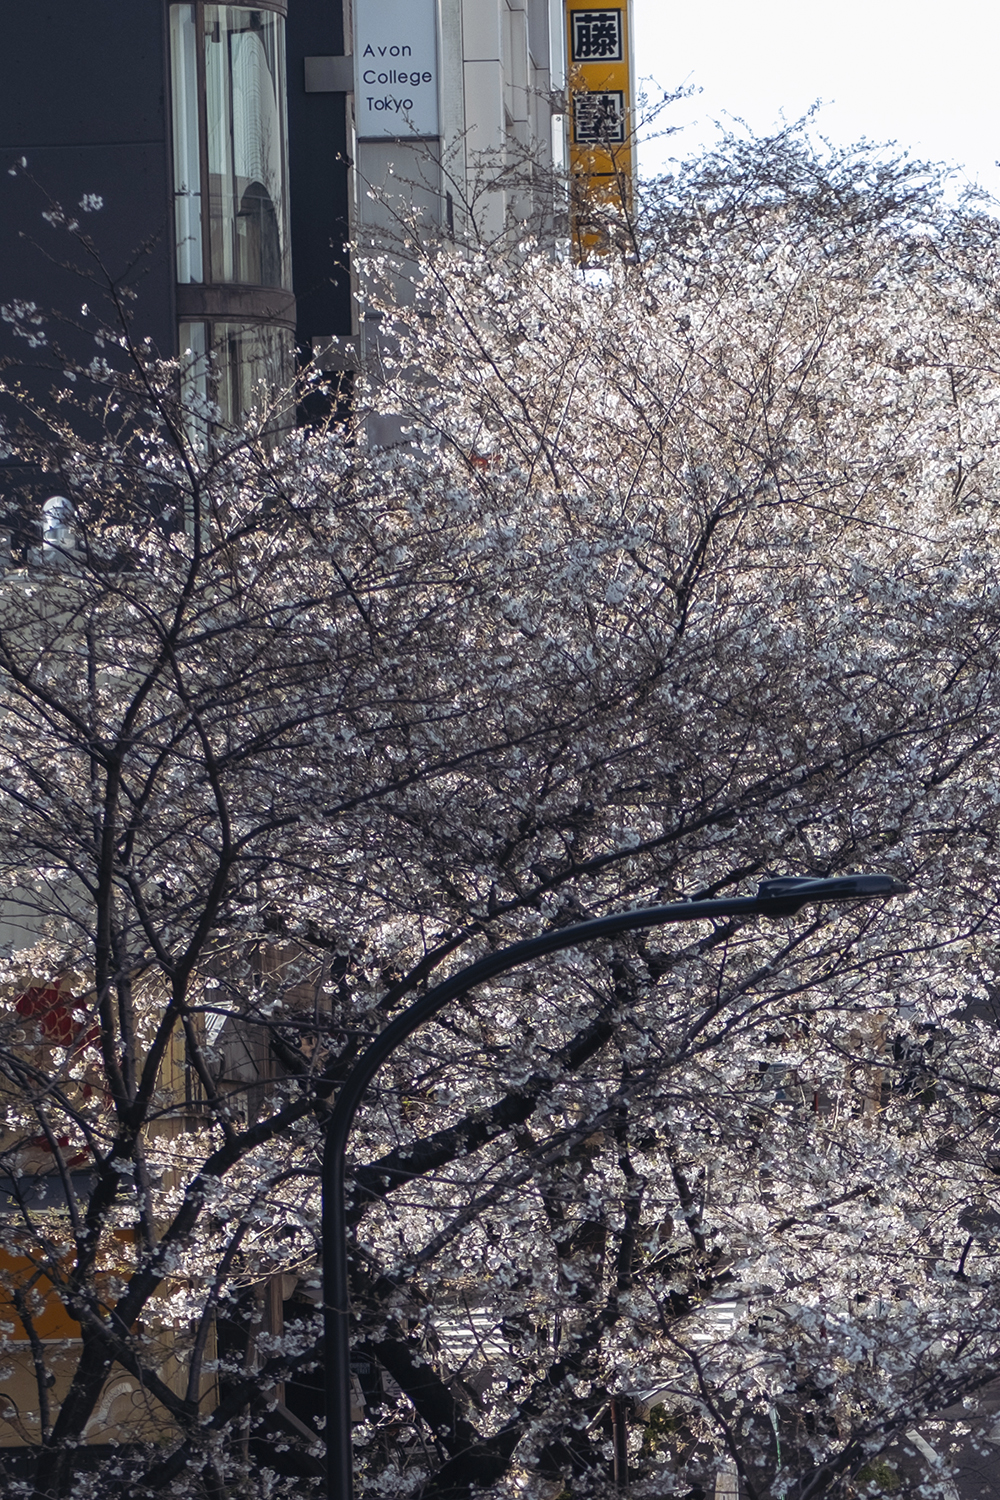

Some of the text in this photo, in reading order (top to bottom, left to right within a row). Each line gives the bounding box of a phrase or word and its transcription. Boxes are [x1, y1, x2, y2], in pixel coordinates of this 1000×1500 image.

[363, 44, 411, 57] Avon
[363, 70, 432, 86] College
[366, 96, 413, 113] Tokyo
